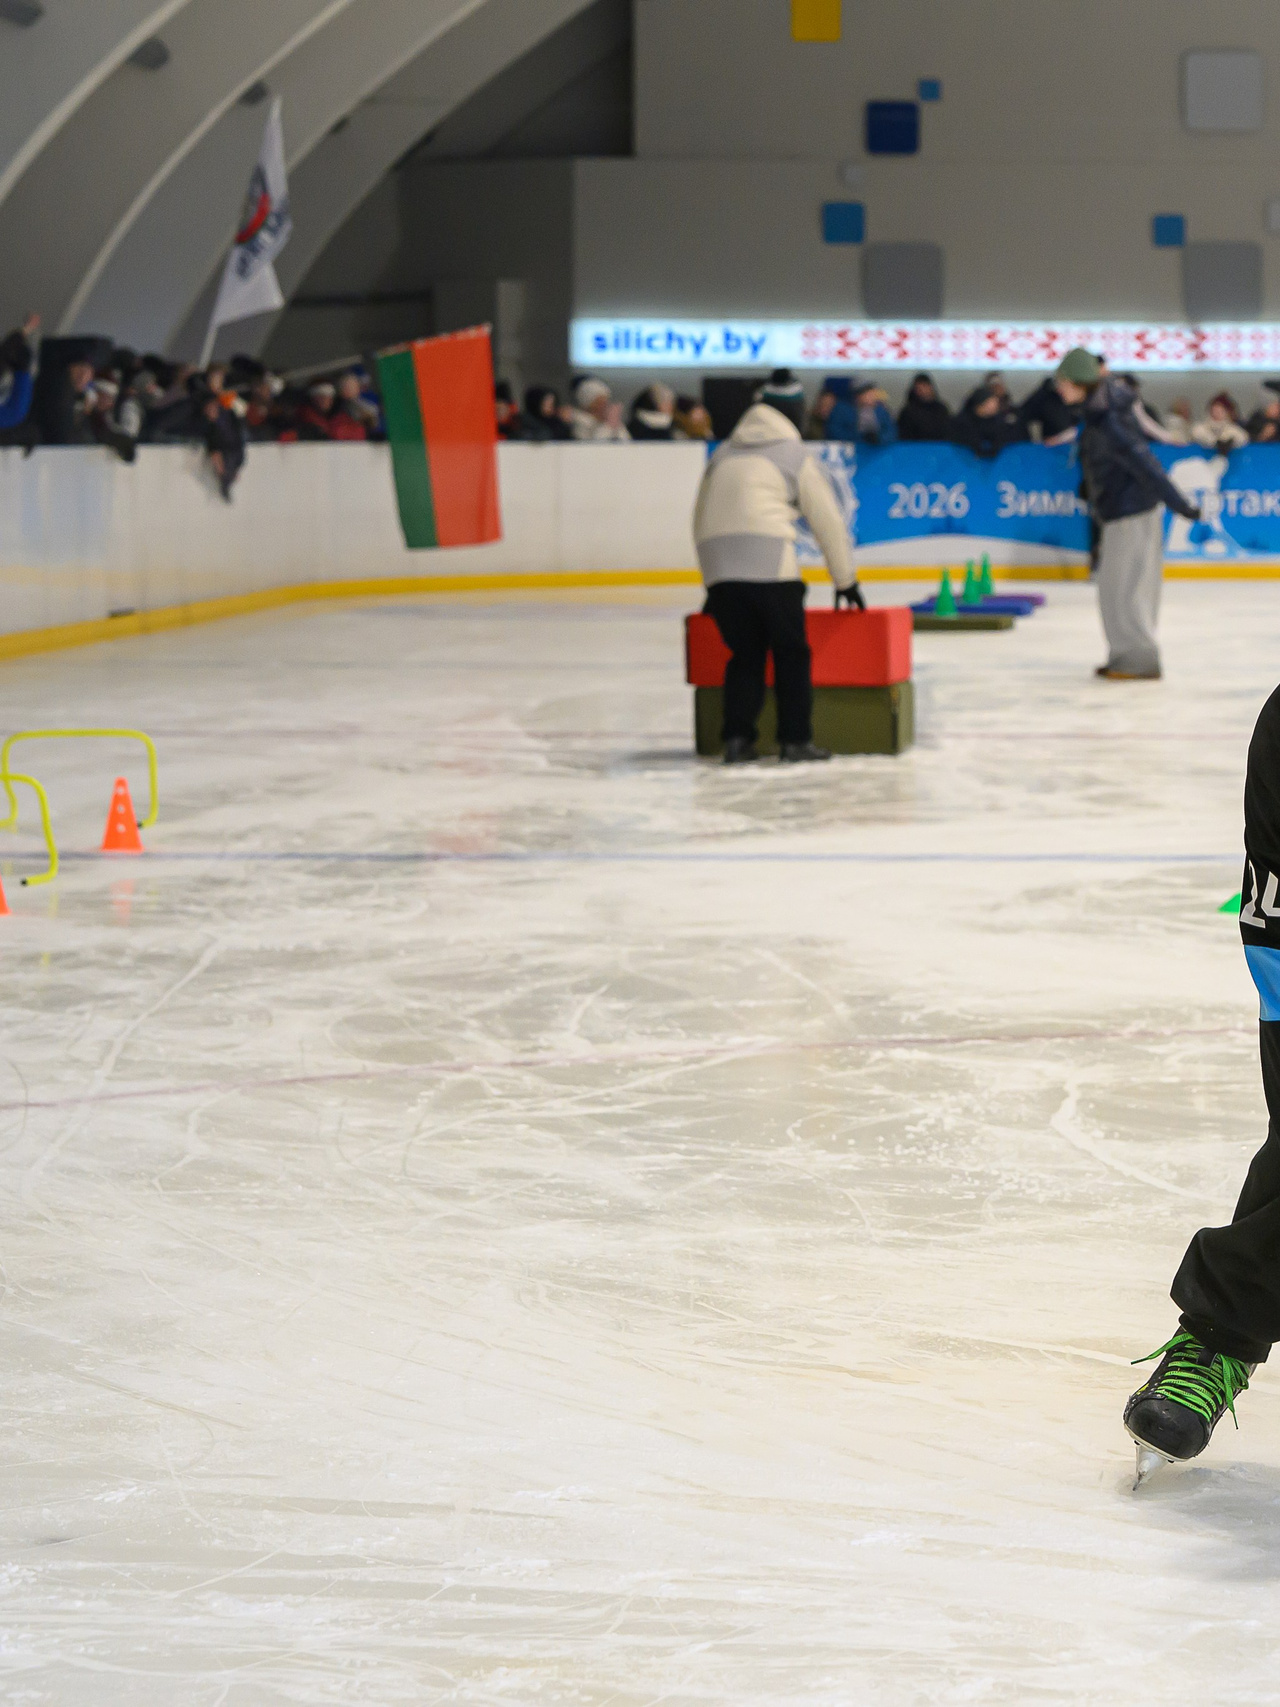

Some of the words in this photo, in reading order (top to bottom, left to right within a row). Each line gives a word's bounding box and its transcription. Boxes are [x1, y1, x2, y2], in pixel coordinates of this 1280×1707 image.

[592, 325, 767, 359] silichy.by
[887, 482, 969, 519] 2026
[996, 481, 1088, 518] Зимн
